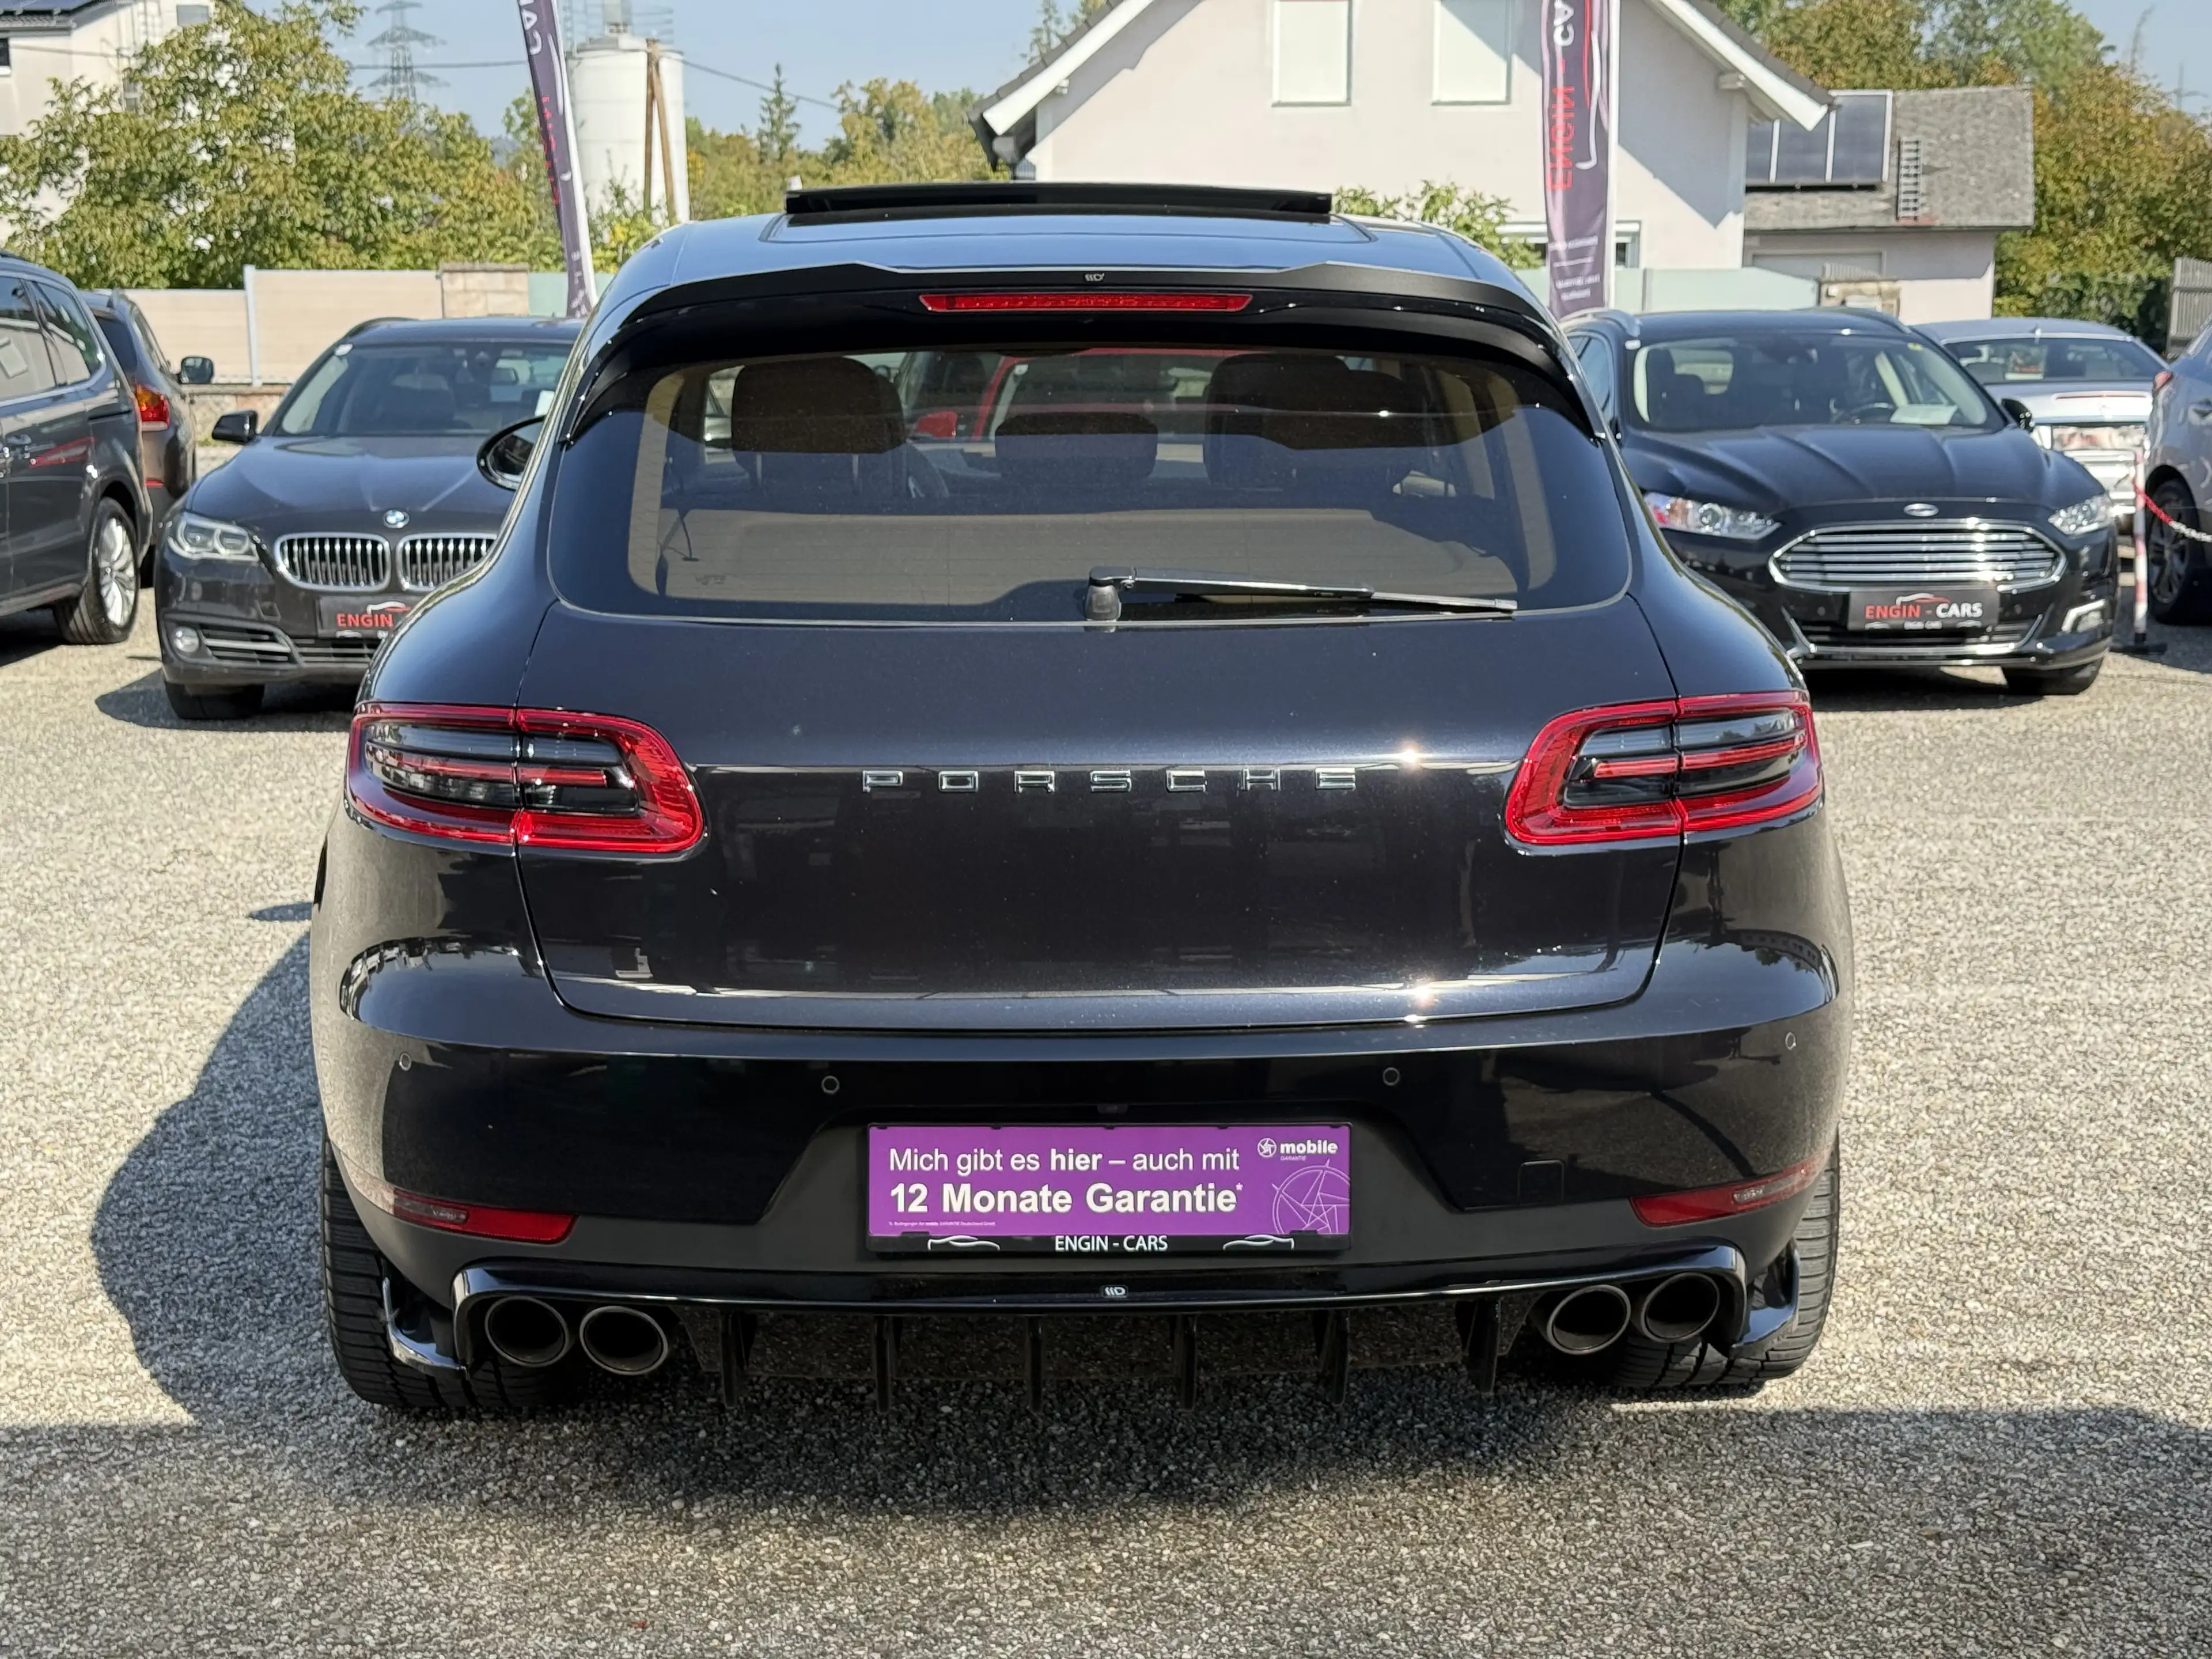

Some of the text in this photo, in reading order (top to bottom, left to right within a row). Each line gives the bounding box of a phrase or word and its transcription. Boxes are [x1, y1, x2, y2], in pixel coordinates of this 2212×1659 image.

[1865, 605, 1921, 619] ENGIN
[1936, 603, 1983, 618] CARS
[336, 612, 393, 627] ENGIN
[862, 767, 1358, 793] PORSCHE
[1280, 1139, 1338, 1154] mobile
[890, 1148, 948, 1171] Mich
[957, 1148, 1003, 1176] gibt
[1010, 1153, 1040, 1171] es
[1051, 1148, 1103, 1171] hier
[1132, 1148, 1193, 1171] auch
[1202, 1148, 1240, 1171] mit
[891, 1183, 929, 1213] 12
[942, 1183, 1073, 1213] Monate
[1055, 1236, 1108, 1252] ENGIN
[1123, 1236, 1168, 1252] CARS
